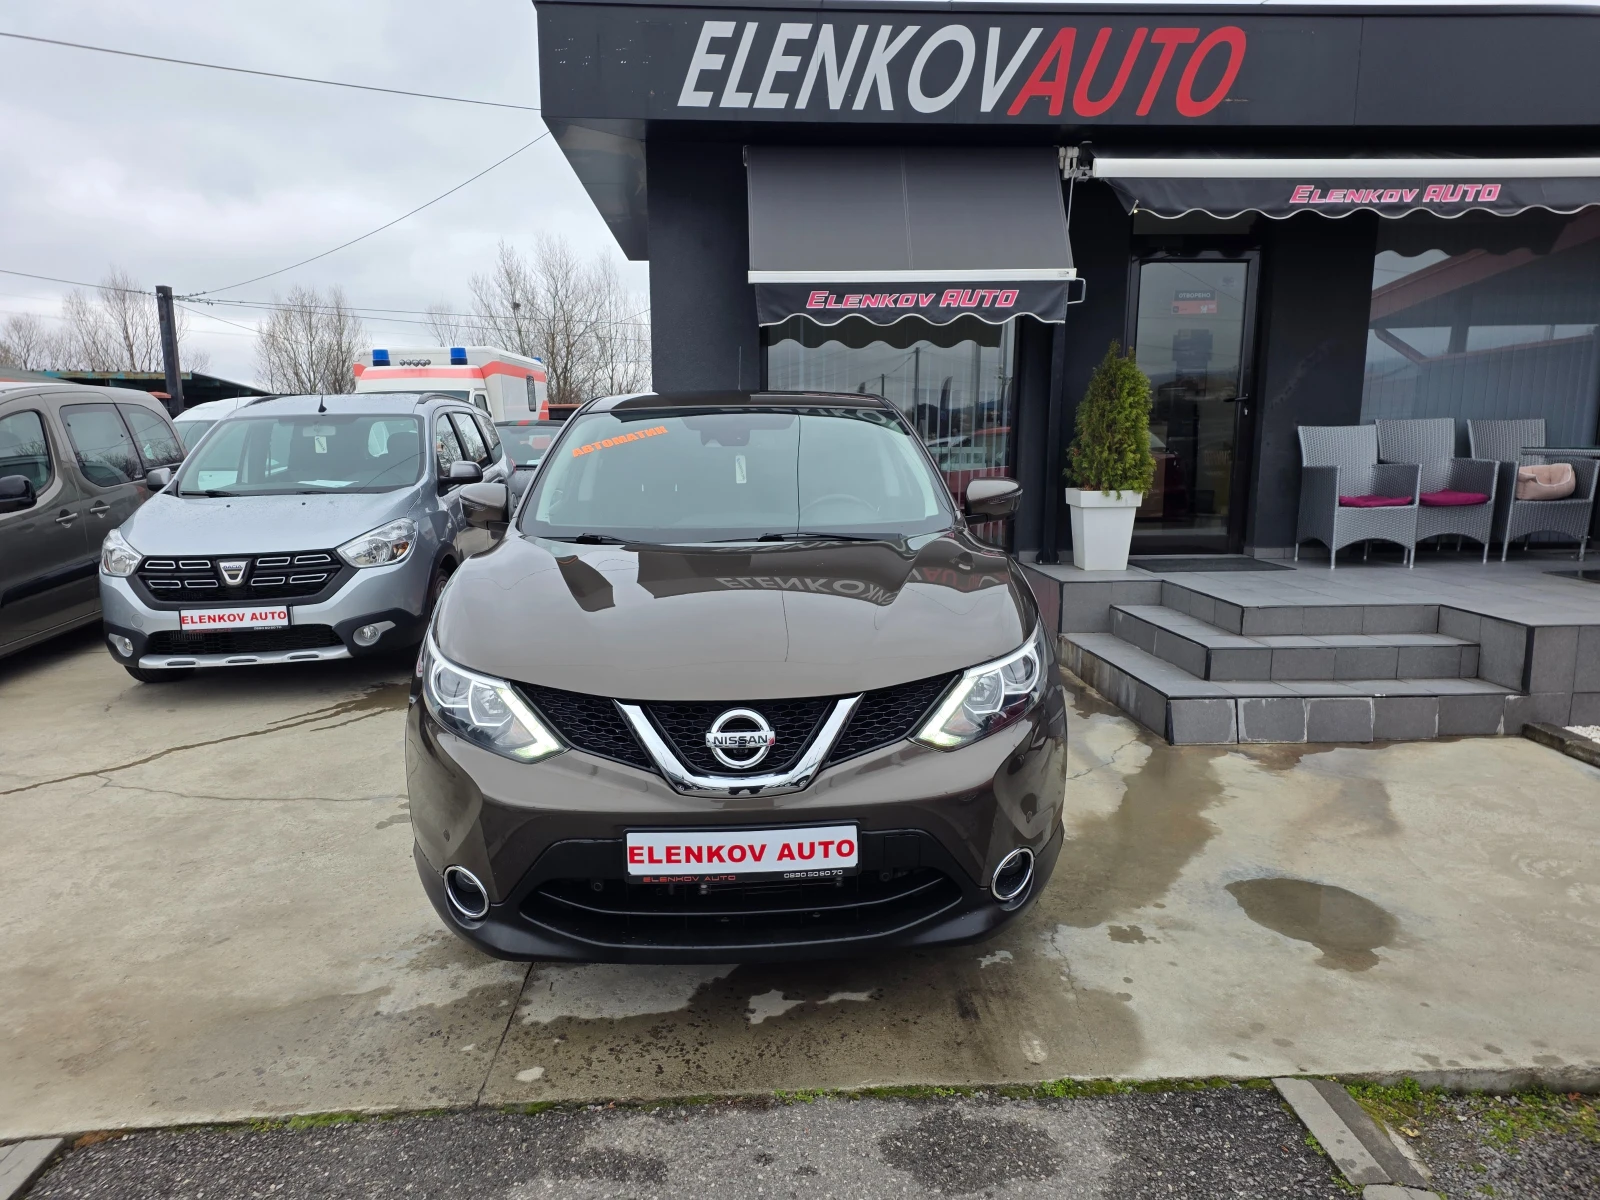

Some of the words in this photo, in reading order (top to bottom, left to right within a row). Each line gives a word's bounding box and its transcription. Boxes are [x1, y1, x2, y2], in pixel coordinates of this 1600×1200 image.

[1422, 183, 1501, 203] AUTO
[939, 289, 1019, 308] AUTO
[572, 425, 669, 457] АВТОМАТИК
[181, 613, 246, 625] ELENKOV
[250, 610, 287, 622] AUTO
[713, 735, 768, 745] NISSAN
[628, 843, 767, 864] ELENKOV
[777, 839, 855, 861] AUTO
